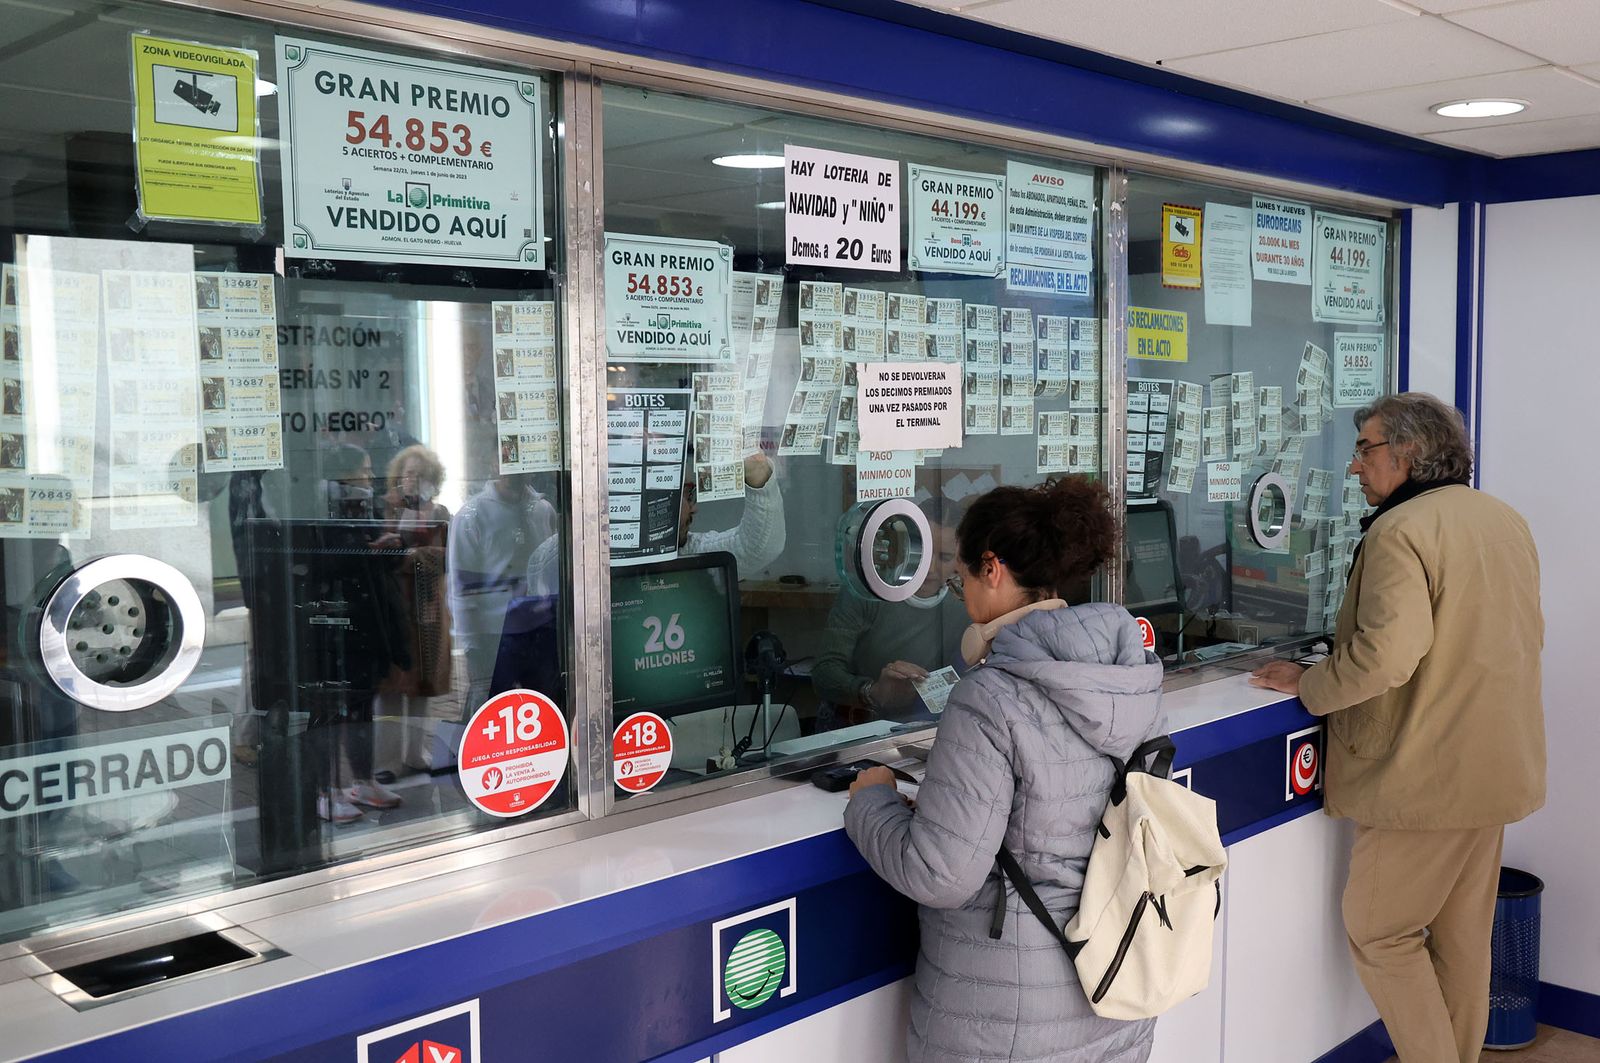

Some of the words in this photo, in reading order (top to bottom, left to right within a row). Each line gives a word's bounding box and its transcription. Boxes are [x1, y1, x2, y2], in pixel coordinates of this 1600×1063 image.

[143, 45, 171, 57] ZONA
[173, 50, 247, 68] VIDEOVIGILADA
[315, 71, 400, 104] GRAN
[411, 84, 510, 118] PREMIO
[346, 110, 472, 156] 54.853
[480, 142, 492, 157] €
[342, 146, 348, 155] 5
[351, 148, 397, 160] ACIERTOS
[408, 154, 494, 170] COMPLEMENTARIO
[373, 166, 392, 174] Semana
[790, 159, 815, 177] HAY
[824, 164, 869, 185] LOTERIA
[878, 171, 892, 187] DE
[1032, 174, 1064, 186] AVISO
[922, 180, 953, 195] GRAN
[956, 184, 994, 199] PREMIO
[388, 190, 404, 203] La
[433, 194, 490, 210] Primitiva
[789, 192, 837, 218] NAVIDAD
[843, 202, 849, 225] y
[931, 199, 979, 220] 44.199
[981, 212, 986, 220] €
[1256, 201, 1275, 210] LUNES
[1282, 207, 1305, 216] JUEVES
[326, 206, 440, 234] VENDIDO
[450, 214, 507, 239] AQUÍ
[1257, 213, 1302, 234] EURODREAMS
[1010, 223, 1016, 232] UN
[1024, 225, 1037, 235] ANTES
[1038, 226, 1043, 236] DE
[1044, 227, 1048, 237] LA
[1073, 232, 1087, 242] SORTEO
[1324, 227, 1346, 242] GRAN
[1349, 231, 1377, 246] PREMIO
[824, 243, 828, 259] a
[836, 237, 863, 260] 20
[871, 243, 892, 264] Euros
[1259, 236, 1280, 247] 20.000€
[1281, 239, 1288, 248] AL
[1289, 240, 1299, 250] MES
[612, 250, 655, 268] GRAN
[660, 254, 714, 272] PREMIO
[924, 246, 966, 260] VENDIDO
[969, 249, 991, 262] AQUÍ
[1256, 252, 1282, 264] DURANTE
[1284, 255, 1290, 266] 30
[1291, 255, 1304, 267] AÑOS
[1330, 246, 1365, 267] 44.199
[225, 279, 258, 288] 13687
[627, 273, 692, 296] 54.853
[697, 287, 703, 296] €
[1057, 272, 1064, 289] EN
[1066, 273, 1072, 290] EL
[1074, 274, 1088, 291] ACTO
[1324, 295, 1354, 308] VENDIDO
[1356, 297, 1373, 310] AQUÍ
[672, 320, 702, 329] Primitiva
[1136, 312, 1184, 332] RECLAMACIONES
[617, 330, 675, 344] VENDIDO
[680, 330, 711, 346] AQUÍ
[1138, 338, 1146, 354] EN
[1148, 339, 1154, 355] EL
[1156, 339, 1170, 356] ACTO
[1340, 342, 1355, 351] GRAN
[1356, 343, 1377, 352] PREMIO
[1344, 355, 1369, 367] 54.853
[230, 378, 264, 386] 13687
[348, 369, 369, 389] Nº
[379, 371, 390, 389] 2
[879, 372, 889, 381] NO
[891, 372, 900, 380] SE
[902, 372, 946, 380] DEVOLVERAN
[865, 388, 879, 397] LOS
[881, 388, 912, 397] DECIMOS
[914, 386, 952, 396] PREMIADOS
[1138, 382, 1160, 392] BOTES
[1340, 388, 1361, 397] VENDIDO
[625, 394, 665, 407] BOTES
[869, 404, 884, 413] UNA
[886, 403, 900, 412] VEZ
[902, 402, 932, 412] PASADOS
[934, 402, 948, 410] POR
[896, 419, 904, 427] EL
[907, 417, 941, 426] TERMINAL
[232, 428, 265, 436] 13687
[870, 451, 892, 460] PAGO
[860, 470, 892, 480] MINIMO
[894, 469, 912, 478] CON
[30, 490, 72, 500] 76849
[859, 488, 892, 498] TARJETA
[895, 487, 904, 496] 10
[905, 487, 910, 496] €
[643, 613, 684, 653] 26
[635, 650, 696, 671] MILLONES
[482, 702, 542, 744] +18
[622, 721, 657, 747] +18
[506, 740, 556, 755] RESPONSABILIDAD
[505, 761, 533, 771] PROHIBIDA
[0, 737, 227, 812] CERRADO
[506, 770, 550, 784] AUTOPROHIBIDOS
